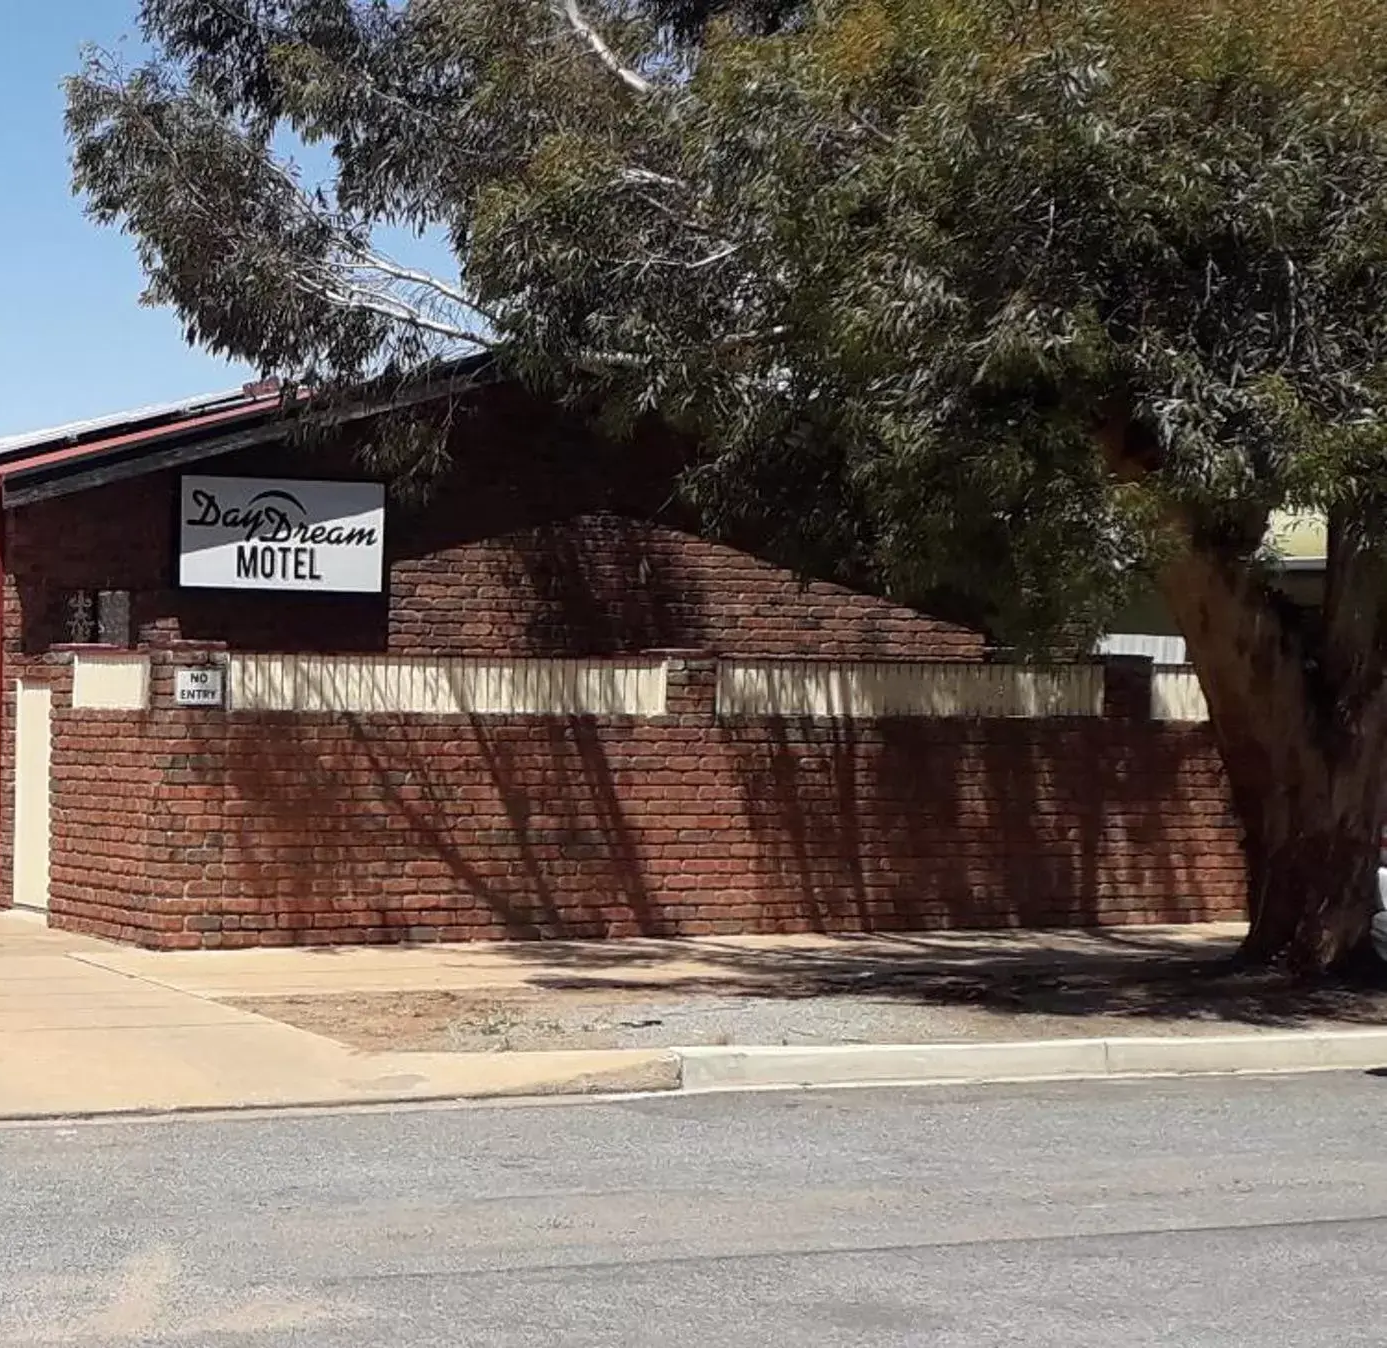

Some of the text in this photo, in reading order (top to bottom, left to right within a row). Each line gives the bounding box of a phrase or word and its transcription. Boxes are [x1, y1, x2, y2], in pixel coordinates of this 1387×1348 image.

[236, 545, 322, 580] MOTEL
[190, 673, 209, 684] NO
[180, 689, 217, 701] ENTRY
